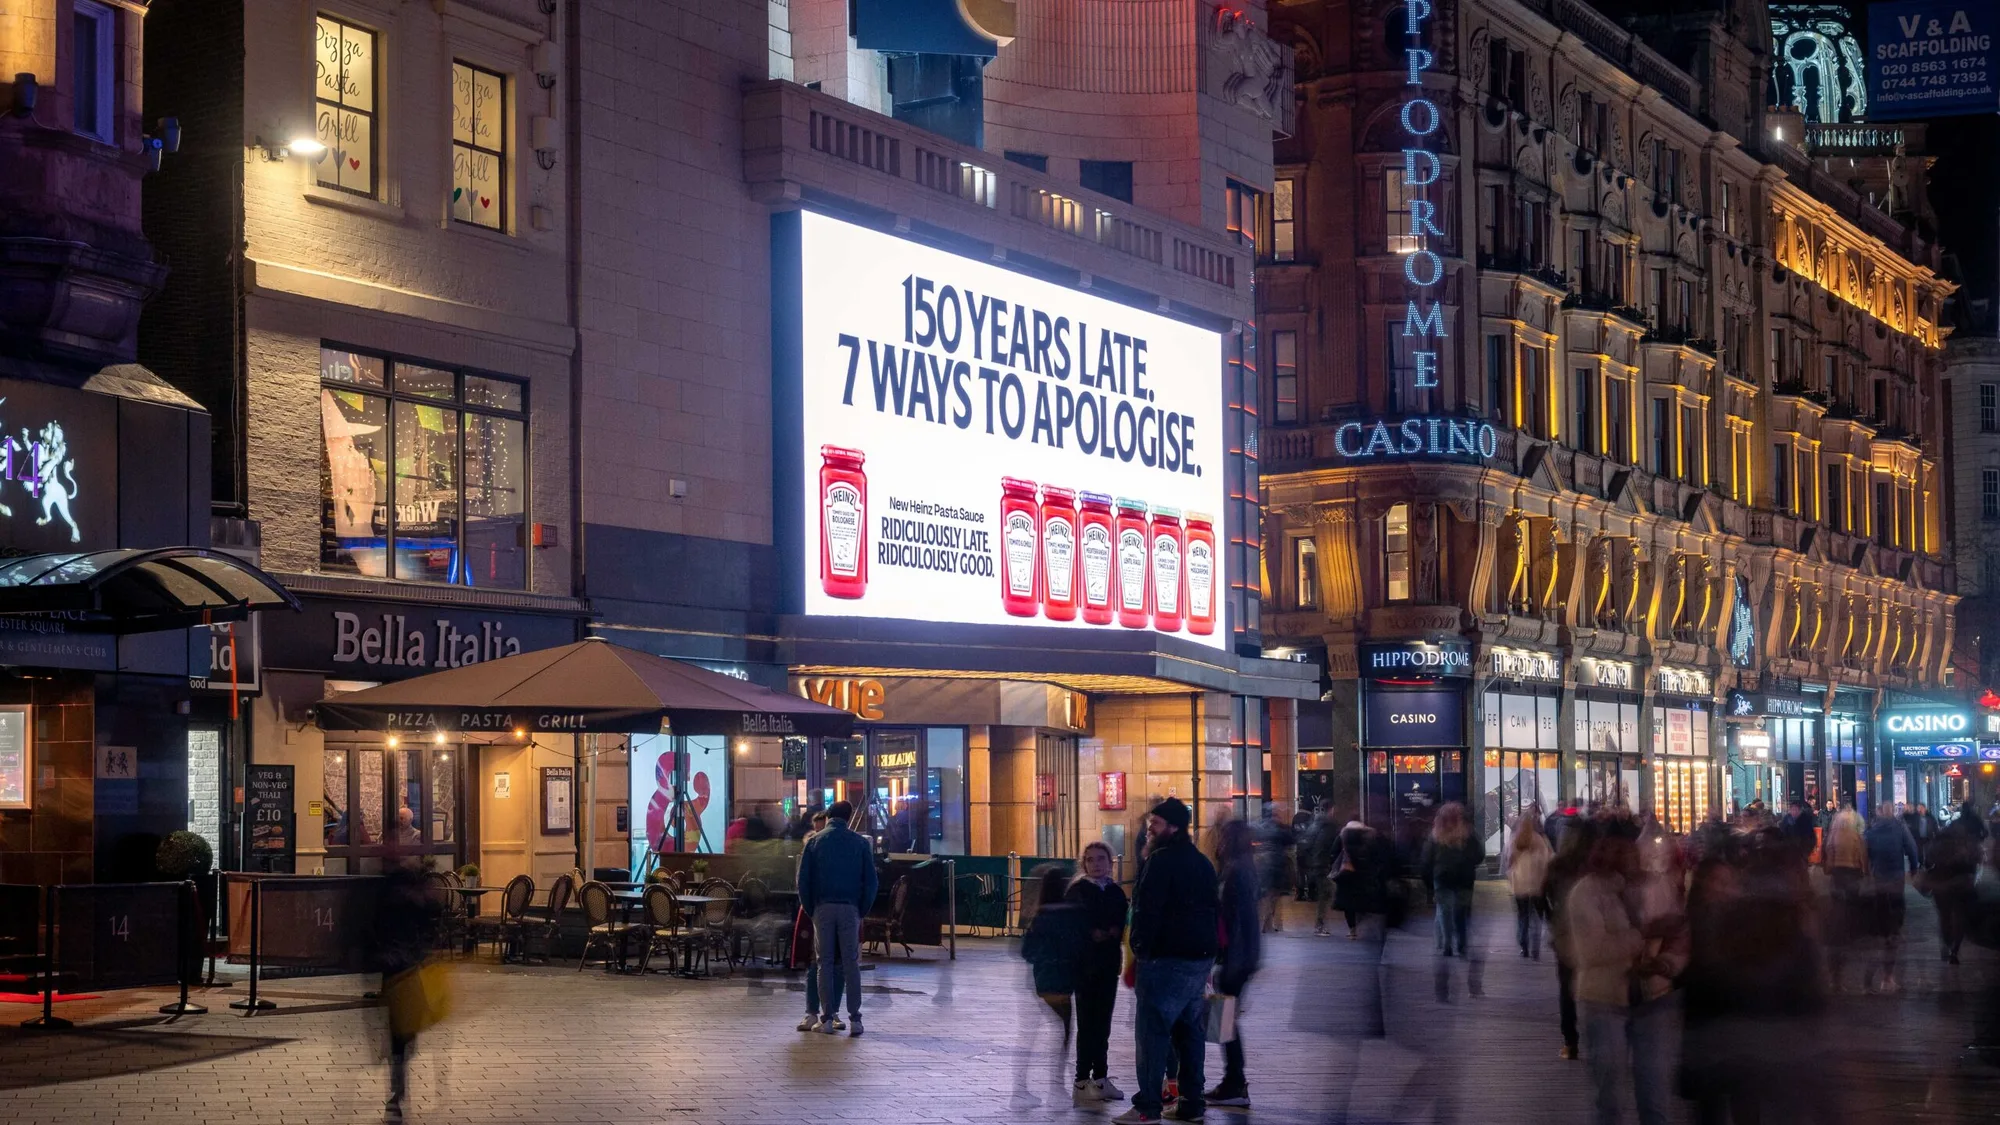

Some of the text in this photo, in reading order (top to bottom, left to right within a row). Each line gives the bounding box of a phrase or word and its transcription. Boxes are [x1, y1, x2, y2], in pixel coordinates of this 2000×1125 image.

[1897, 10, 1972, 38] V & A
[1877, 34, 1991, 60] SCAFFOLDING
[1882, 56, 1986, 75] 020 8563 1674
[1882, 71, 1987, 89] 0744 748 7392
[318, 111, 359, 143] Grill
[454, 153, 490, 181] Grill
[902, 273, 1155, 403] 150 YEARS LATE.
[838, 333, 1202, 478] 7 WAYS TO APOLOGISE.
[1335, 419, 1496, 457] CASINO
[1, 436, 43, 498] 14
[832, 490, 855, 506] HEINZ
[889, 496, 984, 523] New Heinz Pasta Sauce
[832, 516, 855, 525] BOLOGNESE
[1011, 518, 1029, 531] HEINZ
[881, 516, 961, 549] RIDICULOUSLY
[963, 528, 991, 553] LATE.
[1050, 525, 1068, 538] HEINZ
[1088, 530, 1105, 543] HEINZ
[1124, 536, 1140, 549] HEINZ
[1158, 541, 1175, 554] HEINZ
[878, 541, 959, 573] RIDICULOUSLY
[960, 552, 995, 578] GOOD.
[1192, 546, 1208, 559] HEINZ
[30, 620, 65, 635] SQUARE
[332, 611, 520, 668] Bella Italia
[8, 641, 14, 651] &
[18, 642, 80, 656] GENTLEMEN'S
[84, 646, 107, 657] CLUB
[1373, 651, 1469, 667] HIPPODROME
[1493, 653, 1559, 680] HIPPODROME
[1596, 665, 1629, 686] CASINO
[1661, 672, 1711, 695] HIPPODROME
[799, 678, 885, 720] vue
[1767, 698, 1802, 715] HIPPODROME
[388, 713, 587, 728] PIZZA PASTA GRILL
[743, 713, 793, 733] Bella Italia
[1391, 714, 1436, 724] CASINO
[1510, 715, 1527, 728] CAN
[1543, 716, 1552, 730] BE
[1576, 719, 1633, 734] EXTRAORDINARY
[1887, 714, 1966, 732] CASINO
[546, 768, 571, 776] Bella Italia
[252, 781, 287, 789] NON-VEG
[258, 791, 281, 799] THALI
[256, 809, 281, 821] £10
[109, 914, 130, 942] 14
[315, 907, 334, 932] 14
